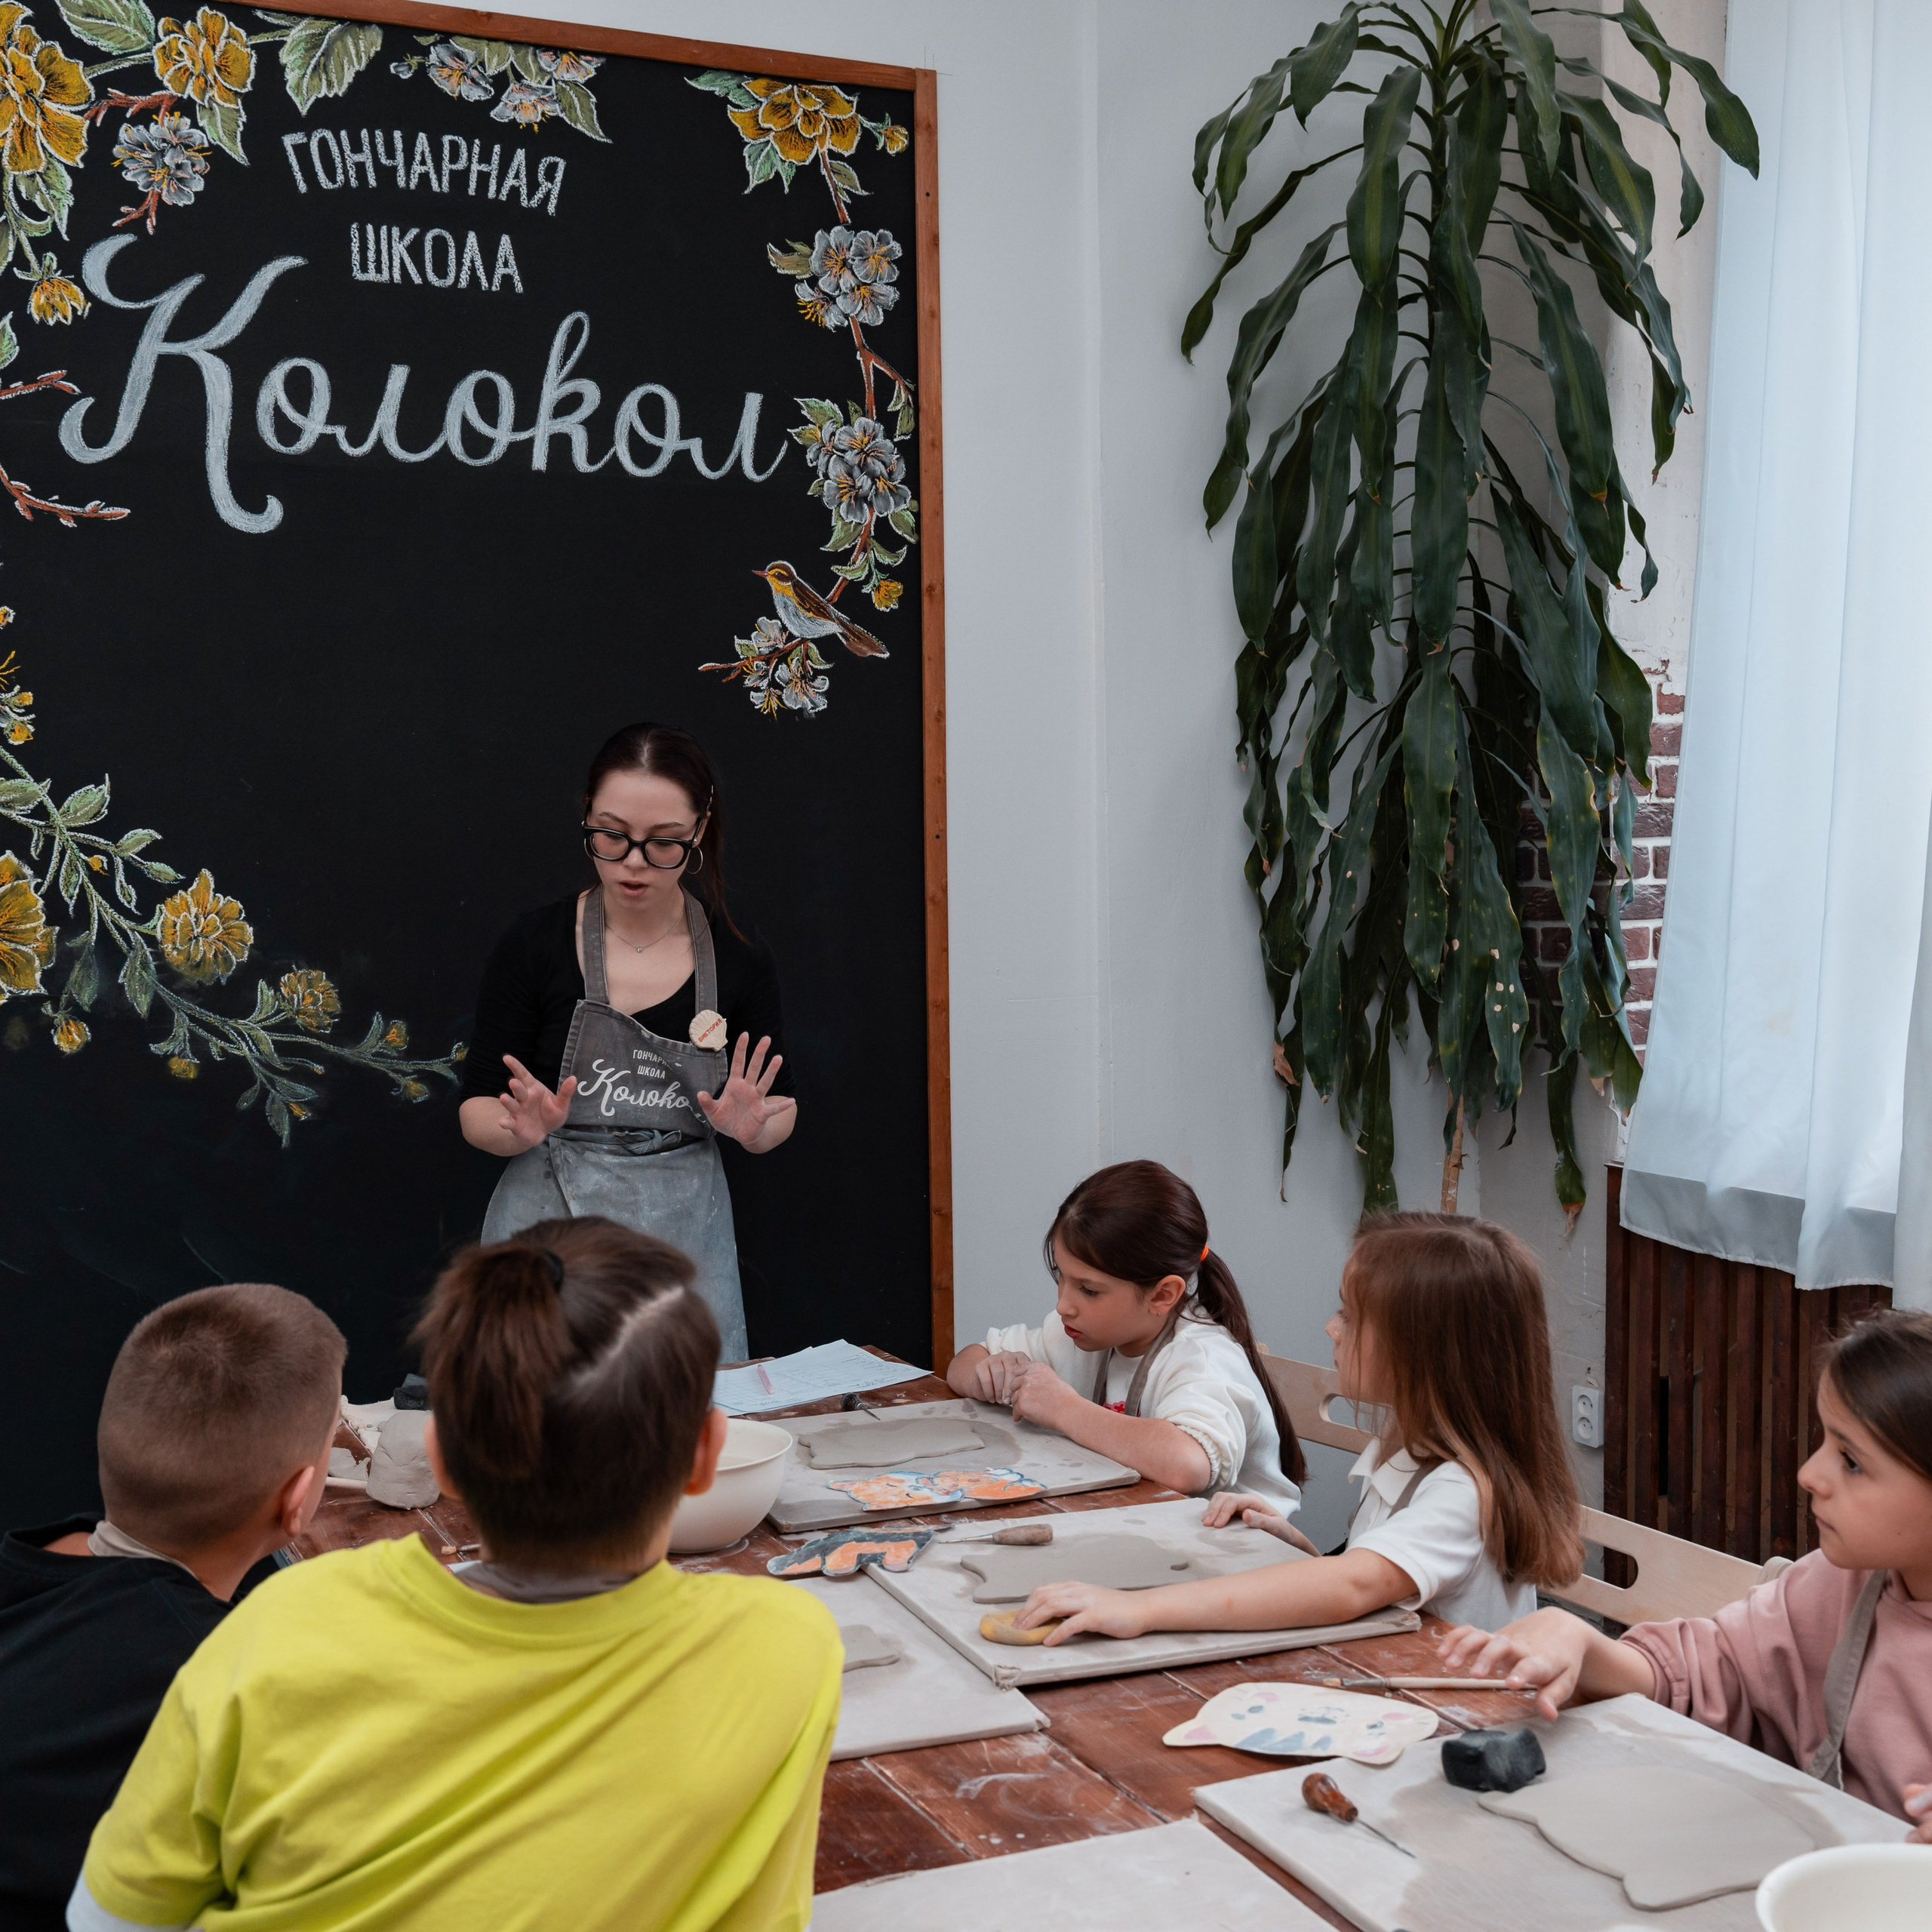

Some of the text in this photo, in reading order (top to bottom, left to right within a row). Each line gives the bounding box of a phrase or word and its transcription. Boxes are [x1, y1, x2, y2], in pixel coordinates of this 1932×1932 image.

[281, 128, 567, 217] ГОНЧАРНАЯ
[350, 222, 524, 294] ШКОЛА
[57, 233, 789, 534] Колокол
[637, 1065, 666, 1079] ШКОЛА
